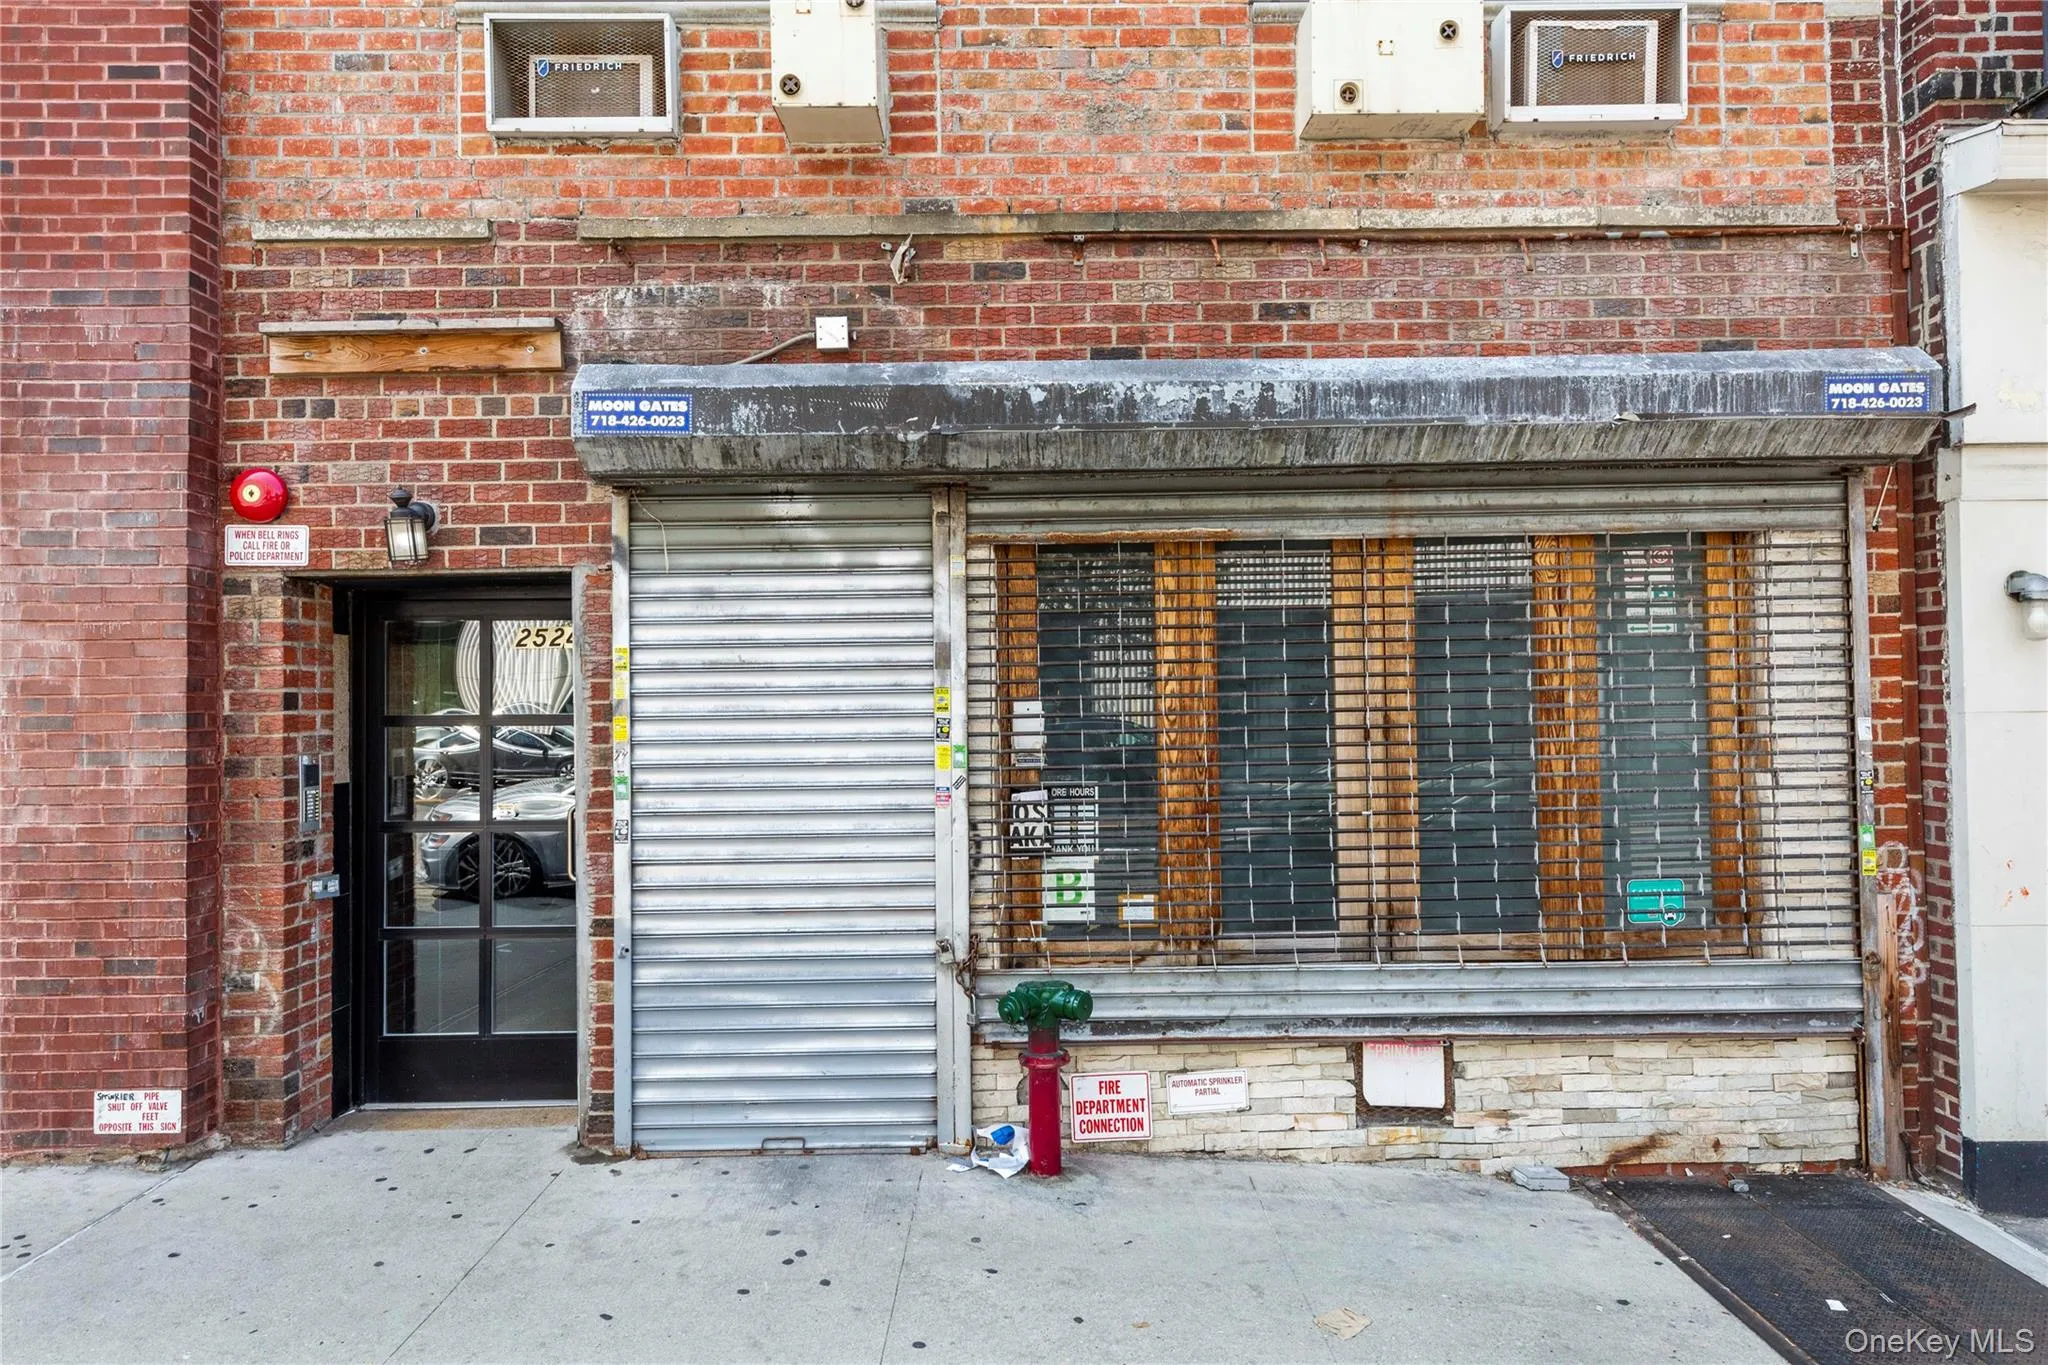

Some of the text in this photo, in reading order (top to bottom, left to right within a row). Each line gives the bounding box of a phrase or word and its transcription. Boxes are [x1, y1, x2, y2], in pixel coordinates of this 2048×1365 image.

[1568, 52, 1636, 62] FRIEDRICH
[554, 62, 622, 72] FRIEDRICH
[1828, 382, 1926, 394] MOON GATES
[587, 400, 688, 412] MOON GATES
[1831, 397, 1923, 408] 718-426-0023
[591, 415, 685, 427] 718-426-0023
[234, 530, 299, 540] WHEN BELL RINGS
[242, 541, 291, 551] CALL FIRE OR
[229, 551, 304, 561] POLICE DEPARTMENT
[1069, 787, 1095, 797] HOURS
[1056, 872, 1082, 904] B
[1171, 1075, 1243, 1088] AUTOMATIC SPRINKLER
[1098, 1080, 1121, 1095] FIRE
[1194, 1087, 1221, 1097] PARTIAL
[144, 1092, 160, 1101] PIPE
[107, 1101, 168, 1112] SHUT OFF VALVE
[1075, 1098, 1146, 1115] DEPARTMENT
[142, 1112, 159, 1121] FEET
[98, 1122, 177, 1132] OPPOSITE THIS SIGN
[1079, 1117, 1145, 1134] CONNECTION
